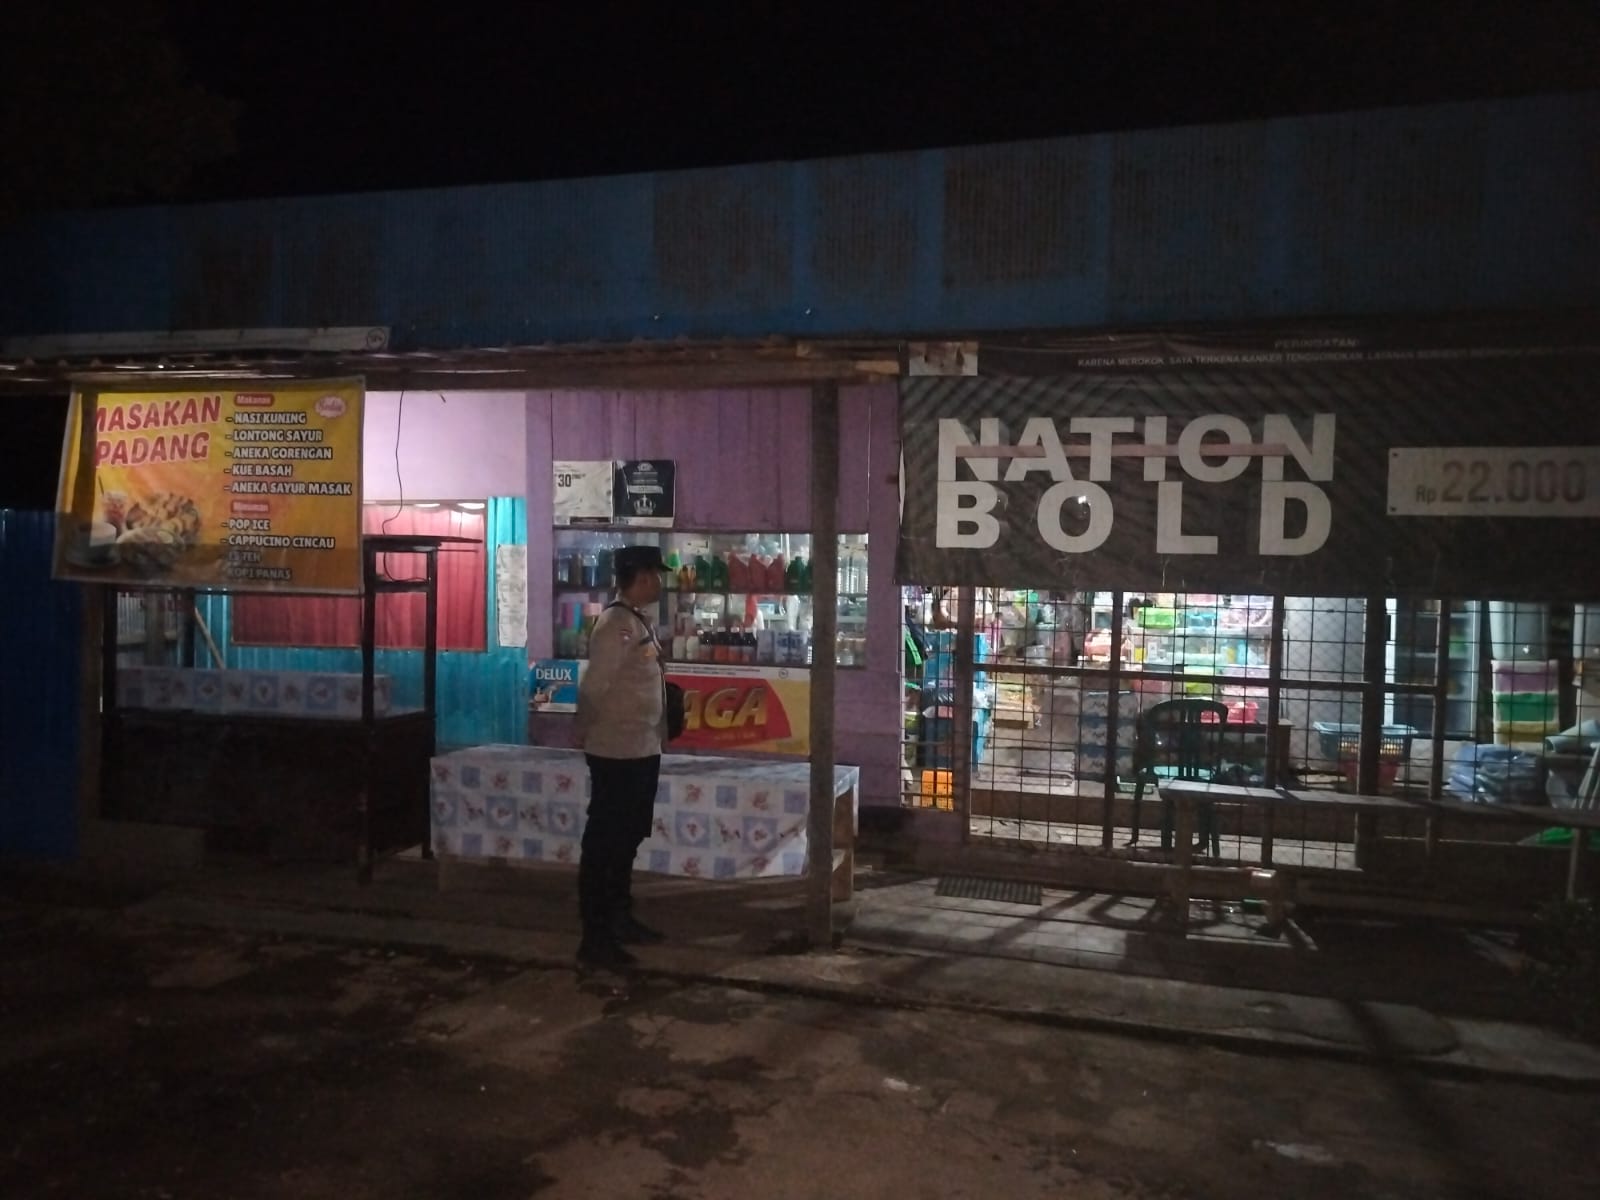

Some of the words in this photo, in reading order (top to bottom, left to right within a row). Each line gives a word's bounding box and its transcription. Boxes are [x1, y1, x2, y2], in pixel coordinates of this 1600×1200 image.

[234, 412, 262, 424] NASI
[263, 412, 307, 425] KUNING
[233, 430, 284, 441] LONTONG
[286, 430, 322, 442] SAYUR
[95, 432, 210, 467] PADANG
[232, 447, 270, 459] ANEKA
[271, 447, 332, 460] GORENGAN
[938, 412, 1337, 483] NATION
[232, 464, 255, 476] KUE
[255, 464, 293, 477] BASAH
[557, 473, 572, 487] 30
[1441, 459, 1587, 504] 22.000
[231, 482, 269, 493] ANEKA
[270, 482, 307, 494] SAYUR
[308, 483, 352, 495] MASAK
[228, 519, 250, 530] POP
[252, 519, 271, 530] ICE
[936, 480, 1333, 557] BOLD
[228, 535, 291, 548] CAPPUCINO
[292, 537, 336, 549] CINCAU
[535, 667, 572, 681] DELUX
